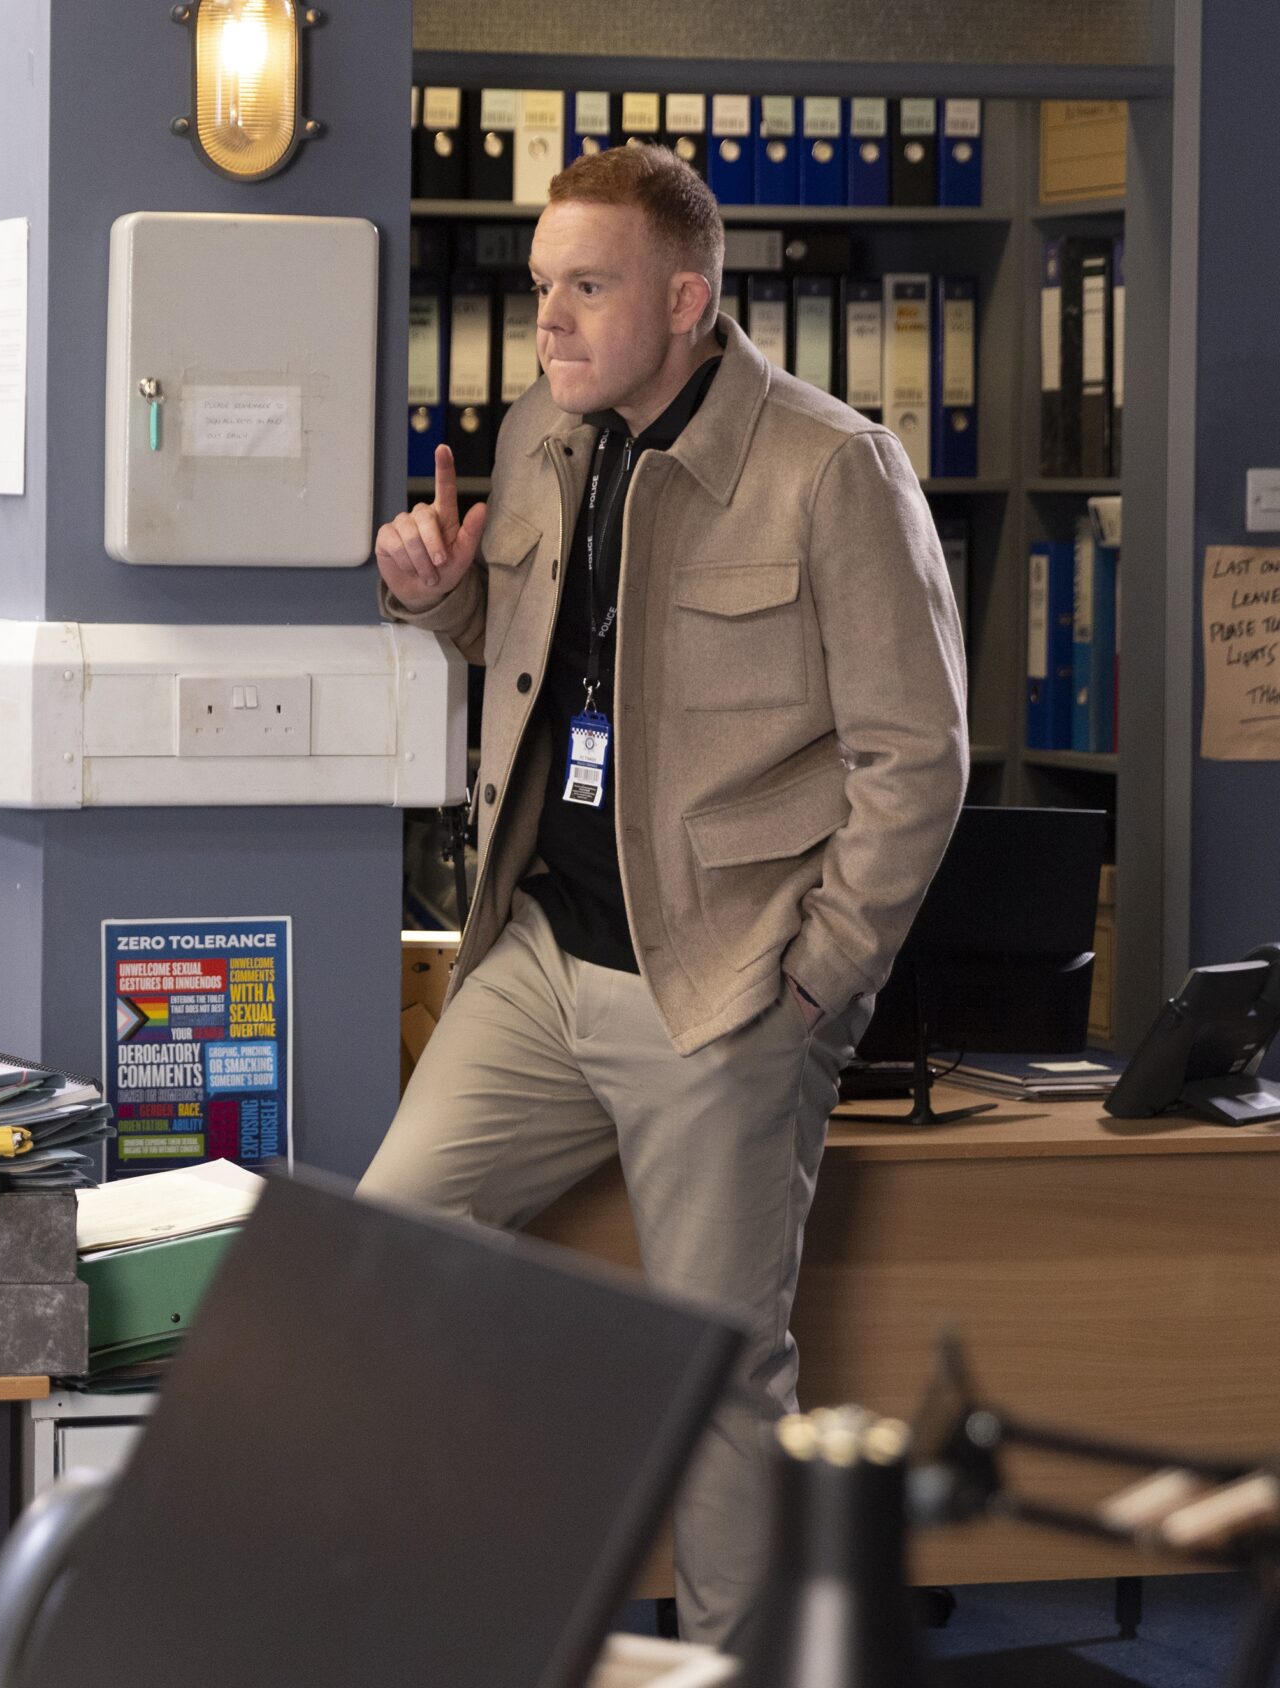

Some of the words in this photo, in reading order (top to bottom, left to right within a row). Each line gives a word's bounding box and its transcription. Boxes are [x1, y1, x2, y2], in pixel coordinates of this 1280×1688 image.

[588, 474, 599, 509] POLICE
[1211, 556, 1255, 580] LAST
[598, 606, 617, 638] POLICE
[117, 935, 165, 950] ZERO
[169, 933, 277, 949] TOLERANCE
[119, 962, 171, 976] UNWELCOME
[172, 961, 203, 975] SEXUAL
[229, 957, 274, 968] UNWELCOME
[119, 977, 161, 991] GESTURES
[162, 977, 174, 990] OR
[175, 975, 222, 990] INNUENDOS
[229, 969, 275, 982] COMMENTS
[196, 995, 207, 1003] THE
[229, 983, 264, 1002] WITH
[266, 982, 276, 1002] A
[229, 1003, 276, 1022] SEXUAL
[171, 1027, 193, 1040] YOUR
[229, 1023, 276, 1038] OVERTONE
[118, 1043, 200, 1064] DEROGATORY
[209, 1058, 223, 1074] OR
[224, 1057, 273, 1073] SMACKING
[118, 1063, 203, 1088] COMMENTS
[253, 1073, 274, 1085] BODY
[172, 1118, 204, 1131] ABILITY
[241, 1099, 259, 1158] EXPOSING
[260, 1099, 278, 1158] YOURSELF
